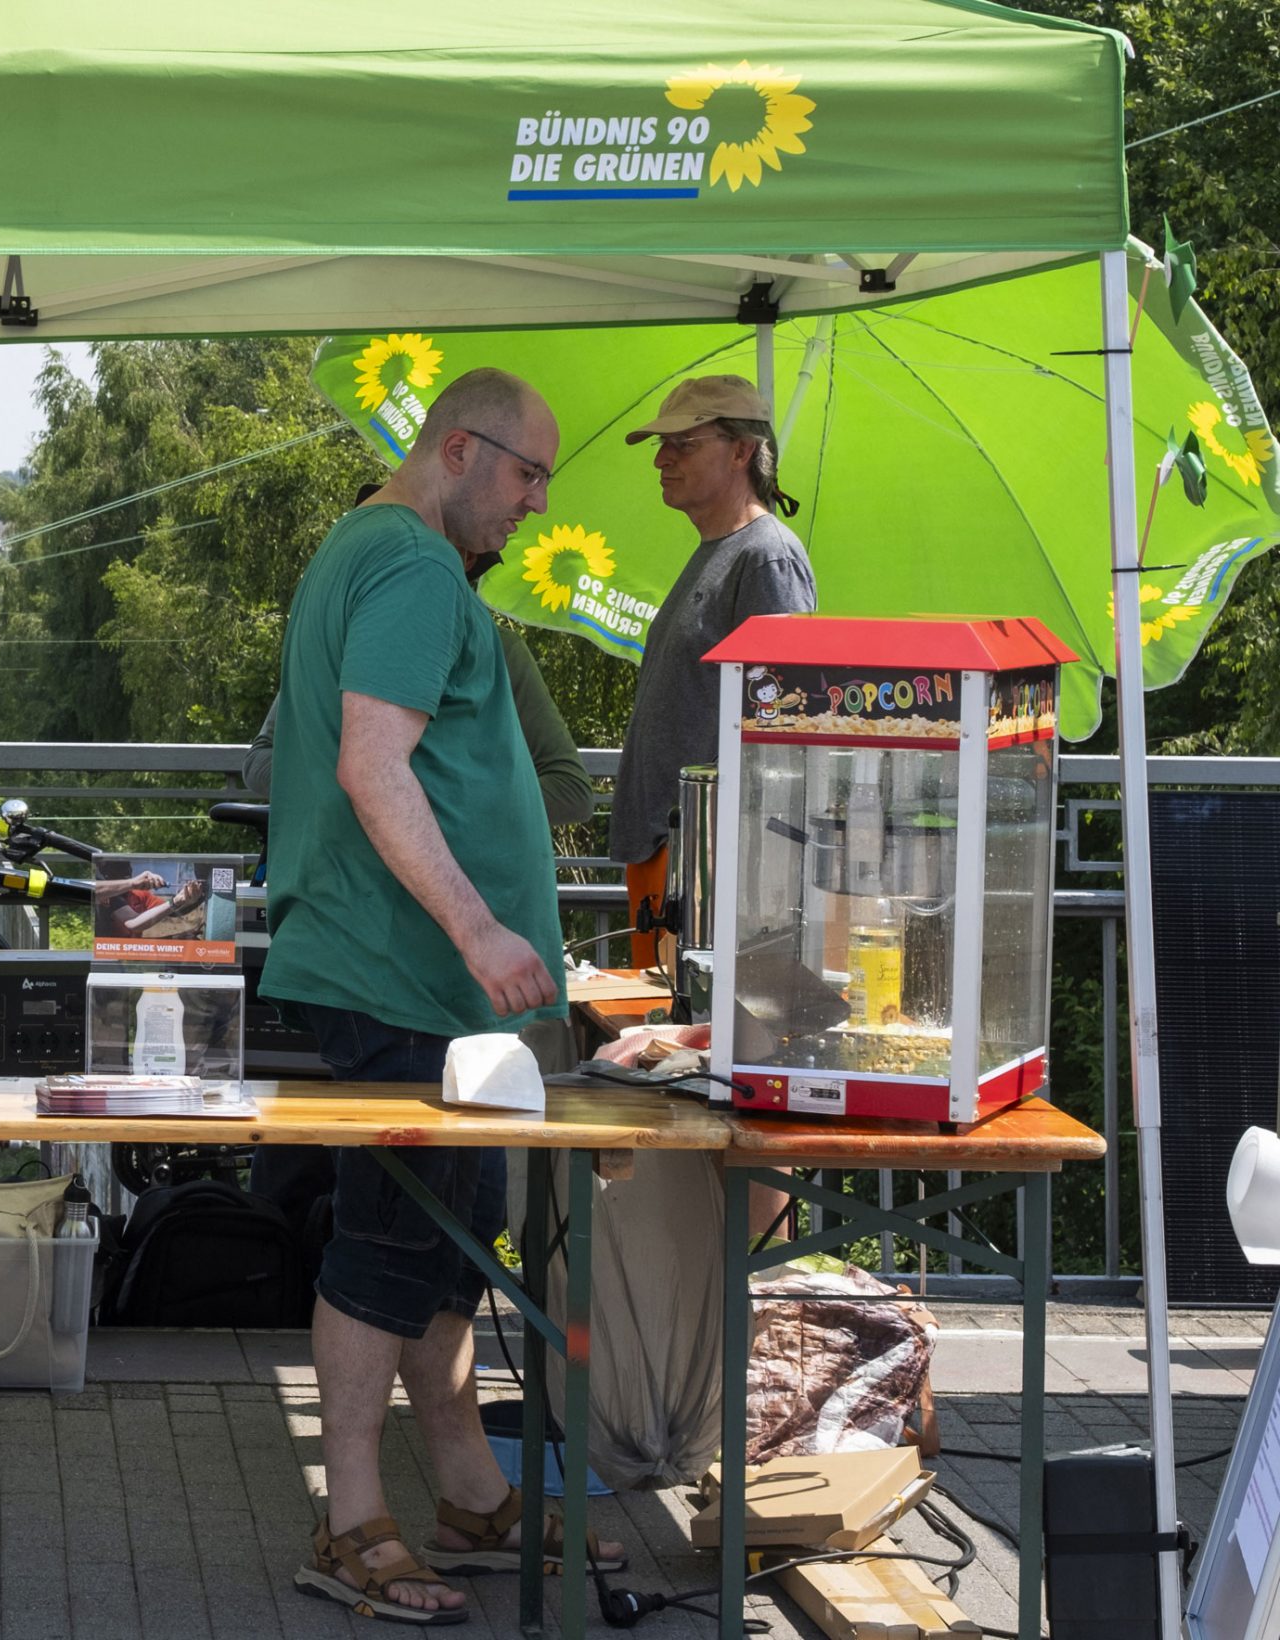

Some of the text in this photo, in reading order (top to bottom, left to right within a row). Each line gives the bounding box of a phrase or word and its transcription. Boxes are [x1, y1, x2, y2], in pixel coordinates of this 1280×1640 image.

[516, 110, 710, 146] BÜNDNIS 90
[510, 146, 705, 182] DIE GRÜNEN
[827, 672, 954, 716] POPCORN
[96, 943, 184, 953] DEINE SPENDE WIRKT
